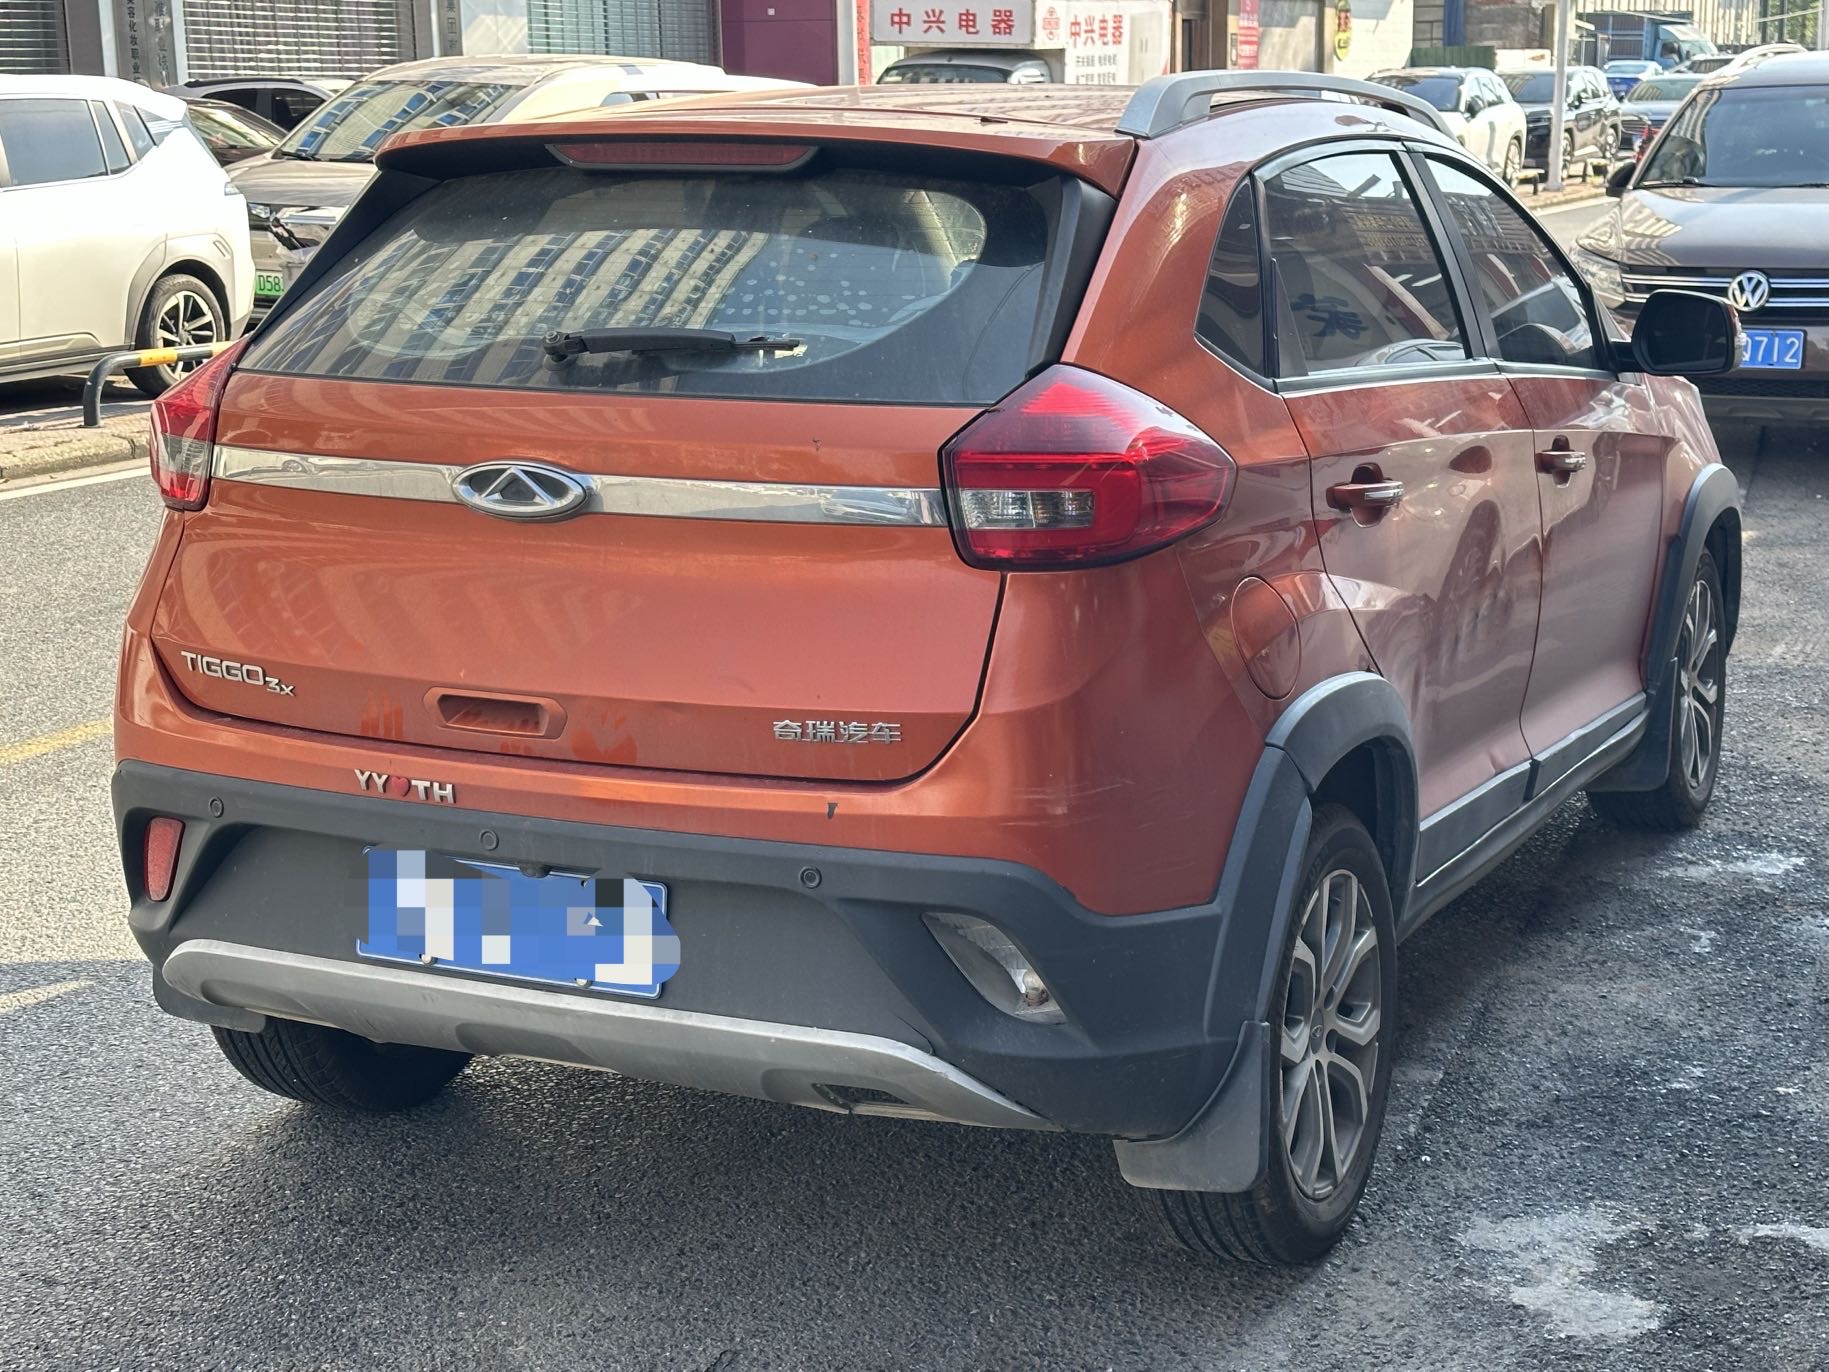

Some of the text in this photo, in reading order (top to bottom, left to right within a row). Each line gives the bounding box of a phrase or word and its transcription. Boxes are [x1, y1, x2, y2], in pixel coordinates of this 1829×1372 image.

[890, 7, 1015, 35] 中兴电器
[1070, 14, 1123, 48] 中兴电器
[257, 274, 284, 293] D58
[773, 719, 902, 744] 奇瑞汽车
